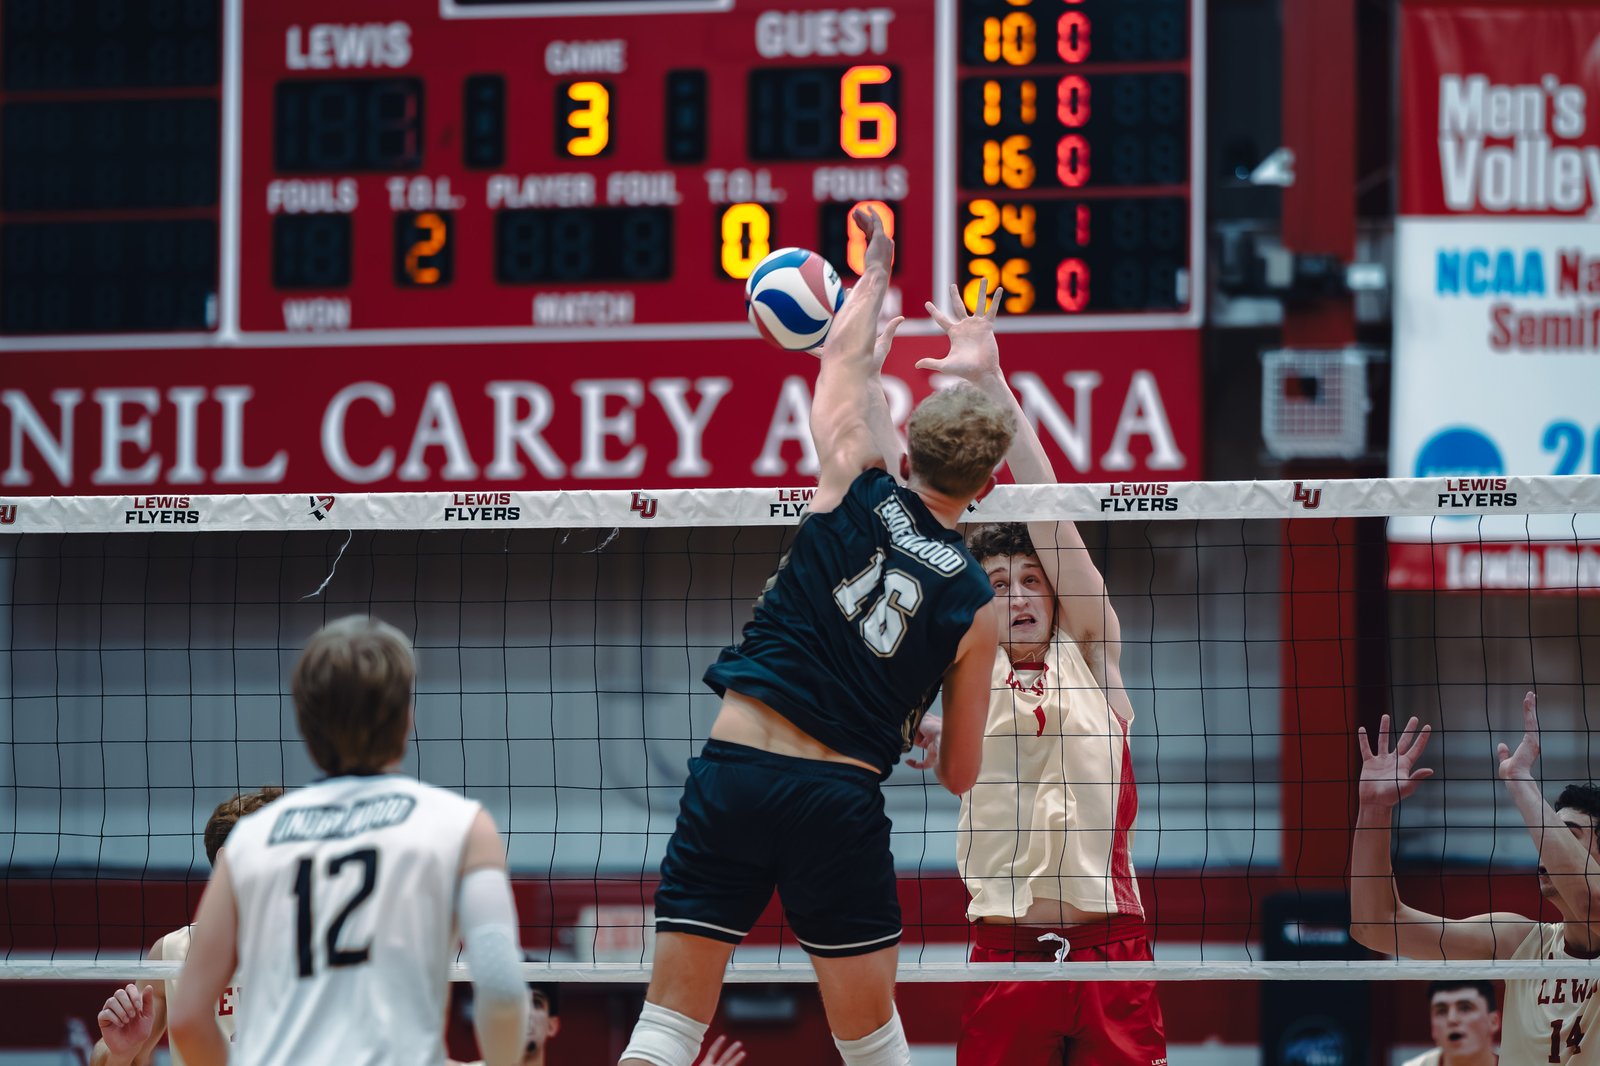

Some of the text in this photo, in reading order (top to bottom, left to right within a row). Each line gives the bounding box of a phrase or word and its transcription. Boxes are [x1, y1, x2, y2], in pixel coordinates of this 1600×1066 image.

[285, 21, 412, 70] LEWIS
[545, 40, 627, 74] GAME
[755, 9, 895, 58] GUEST
[983, 10, 1092, 65] 10 0
[567, 81, 609, 157] 3
[840, 65, 897, 159] 6
[983, 74, 1092, 128] 11 0
[1438, 73, 1587, 139] Men's
[813, 166, 908, 201] FOULS
[983, 133, 1092, 189] 16 0
[267, 178, 358, 213] FOULS
[487, 170, 681, 209] PLAYER FOUL
[404, 212, 447, 285] 2
[721, 203, 771, 279] 0
[963, 199, 1037, 255] 24
[1056, 257, 1091, 312] 0
[1435, 248, 1546, 297] NCAA
[0, 386, 289, 488] NEIL
[320, 376, 732, 485] CAREY
[1541, 417, 1600, 475] 2
[134, 497, 190, 509] LEWIS
[453, 493, 511, 506] LEWIS
[630, 492, 658, 520] LU
[779, 489, 817, 502] LEW
[1101, 497, 1178, 512] FLYERS
[1110, 483, 1169, 497] LEWIS
[1293, 481, 1321, 510] LU
[1438, 493, 1517, 508] FLYERS
[1447, 478, 1507, 492] LEWIS
[126, 510, 200, 525] FLYERS
[444, 507, 520, 522] FLYERS
[770, 503, 809, 518] FLY
[834, 551, 923, 657] 16
[1033, 705, 1047, 737] 1
[294, 847, 379, 980] 12
[1548, 1014, 1585, 1064] 14
